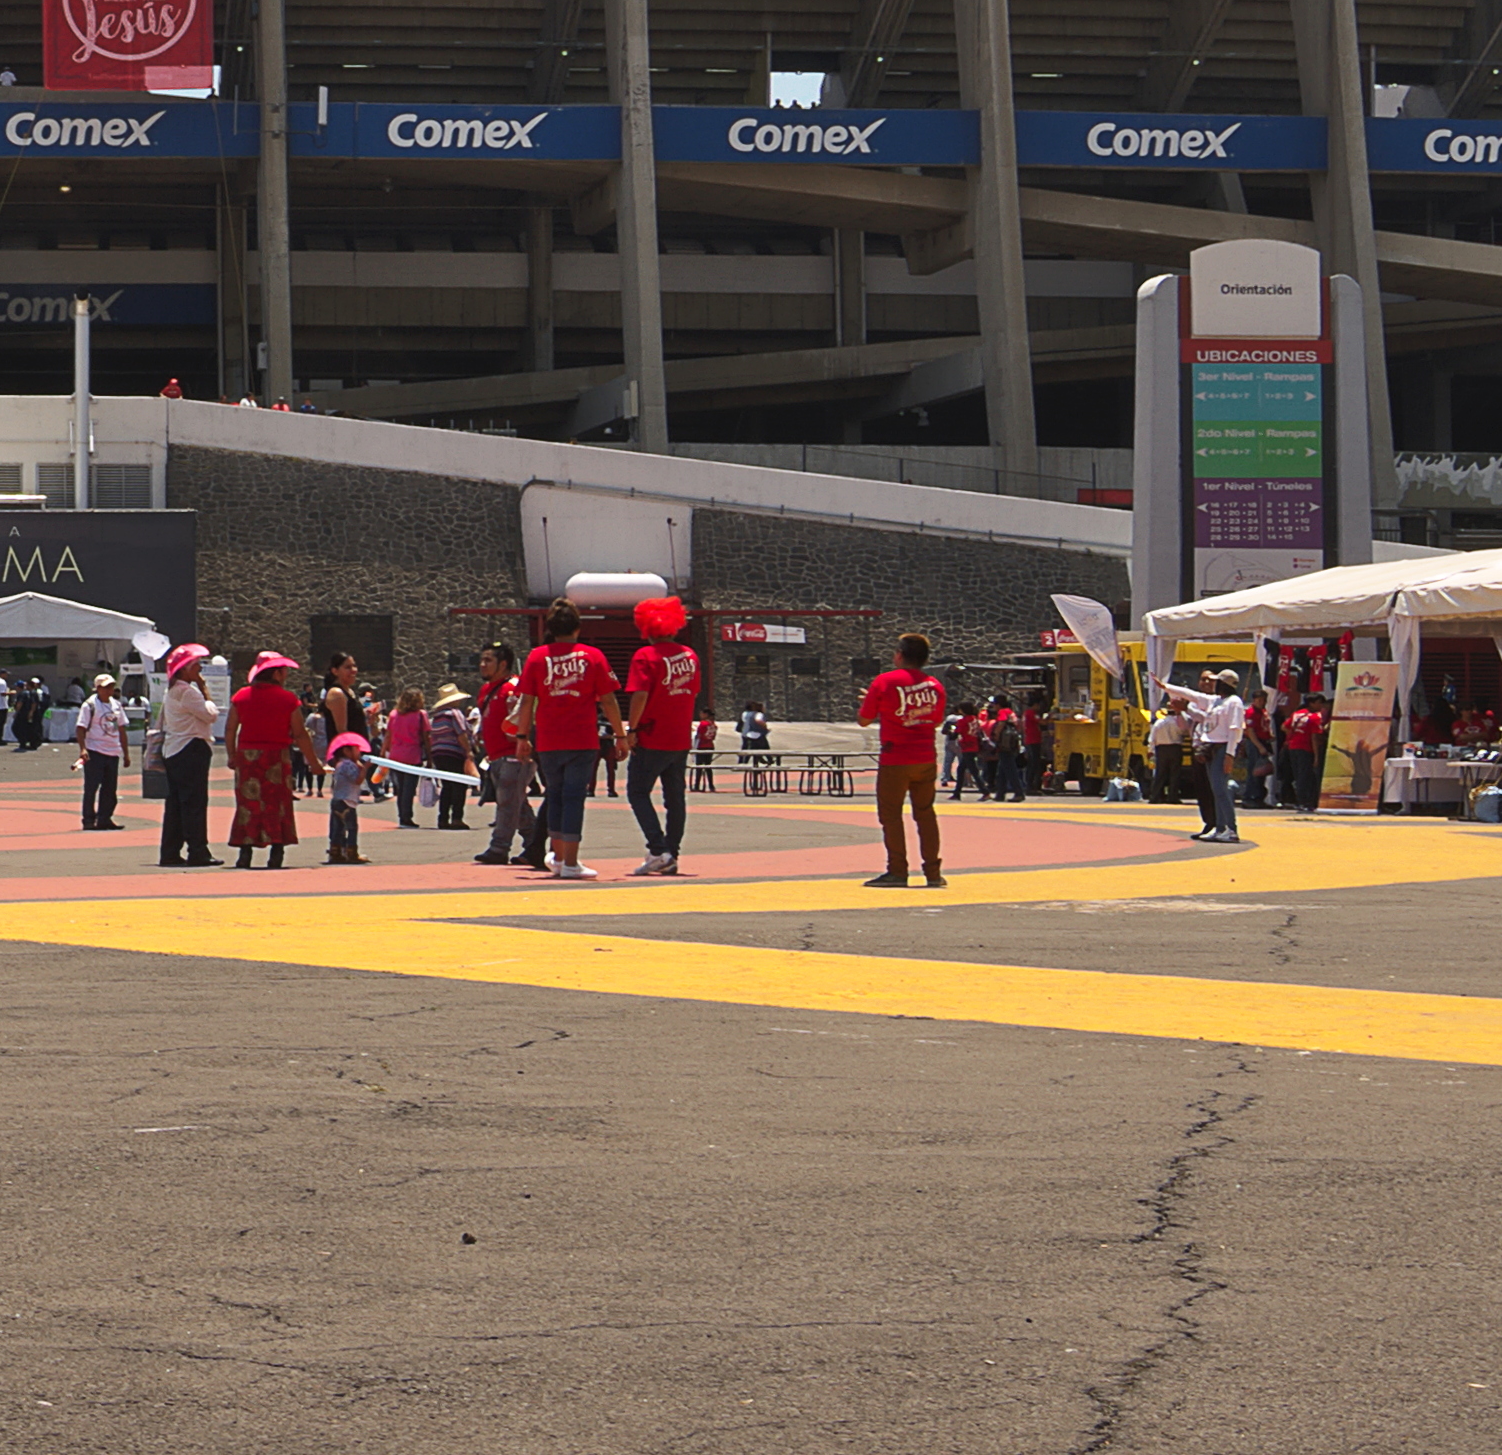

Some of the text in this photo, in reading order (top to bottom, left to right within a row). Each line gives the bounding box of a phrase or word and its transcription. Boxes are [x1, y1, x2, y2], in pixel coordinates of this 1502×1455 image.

[5, 111, 165, 148] Comex
[387, 112, 548, 150] Comex
[728, 118, 886, 155] Comex
[1087, 122, 1241, 159] Comex
[1220, 283, 1293, 296] Orientación
[1196, 350, 1318, 363] UBICACIONES
[1045, 636, 1054, 645] 2
[543, 656, 588, 686] Jesús
[894, 686, 938, 716] Jesús
